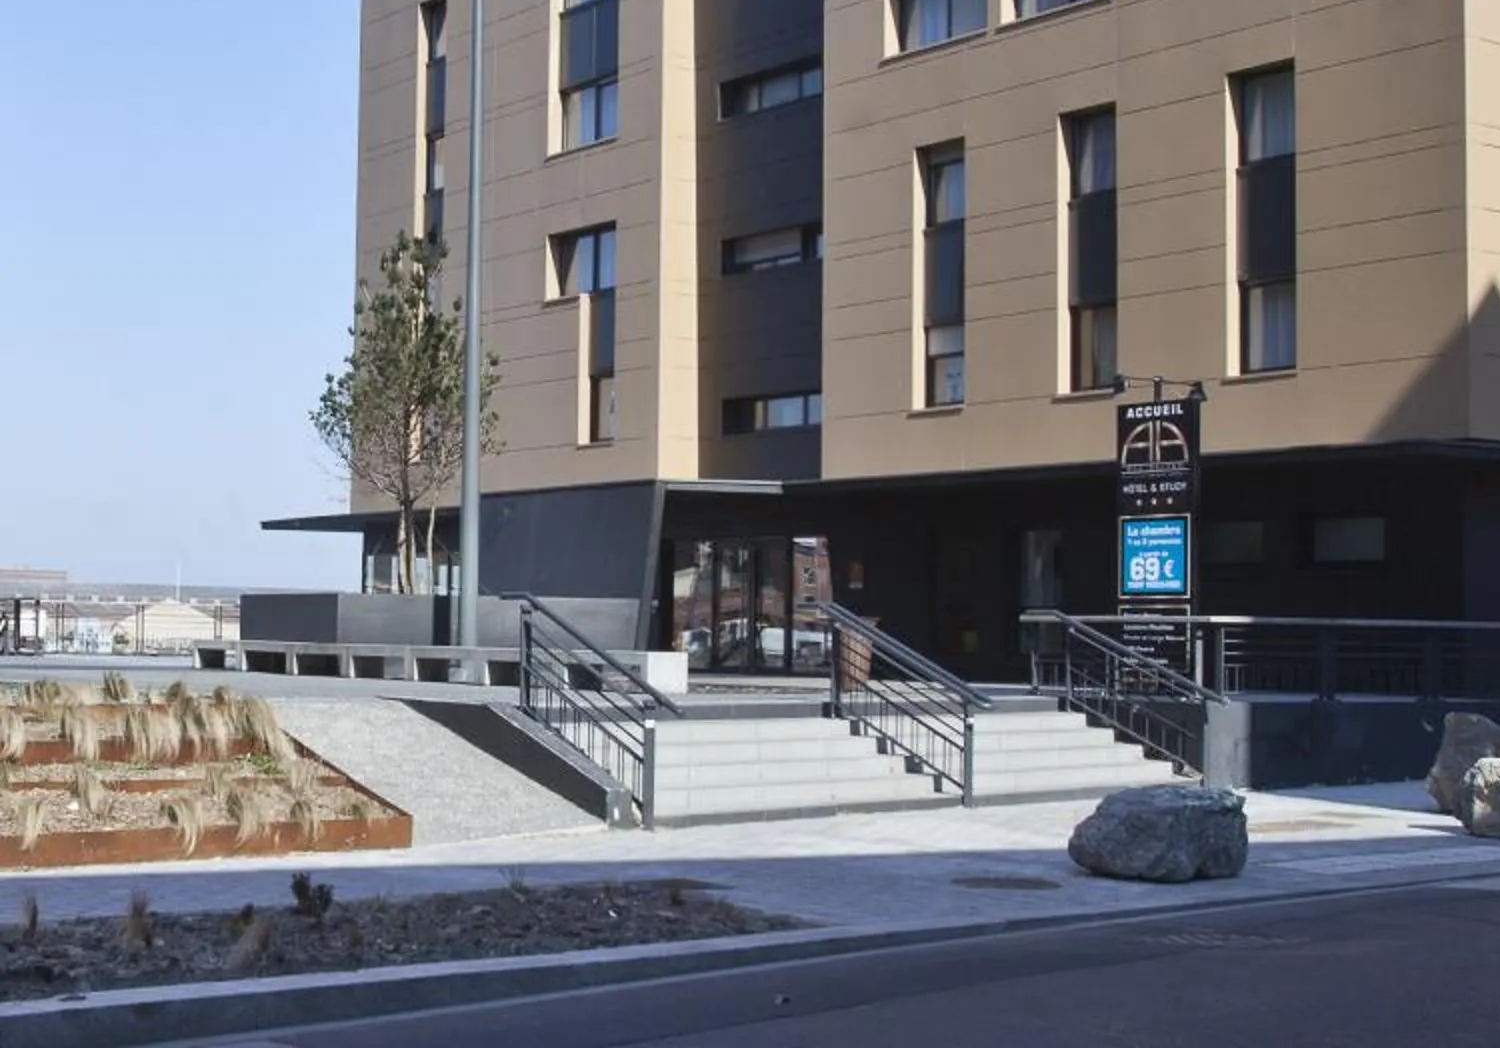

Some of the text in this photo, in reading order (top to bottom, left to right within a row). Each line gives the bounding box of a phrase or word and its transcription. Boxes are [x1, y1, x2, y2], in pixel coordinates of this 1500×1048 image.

[1126, 404, 1184, 419] ACCUEIL
[1127, 525, 1139, 537] La
[1129, 556, 1176, 581] 69 €
